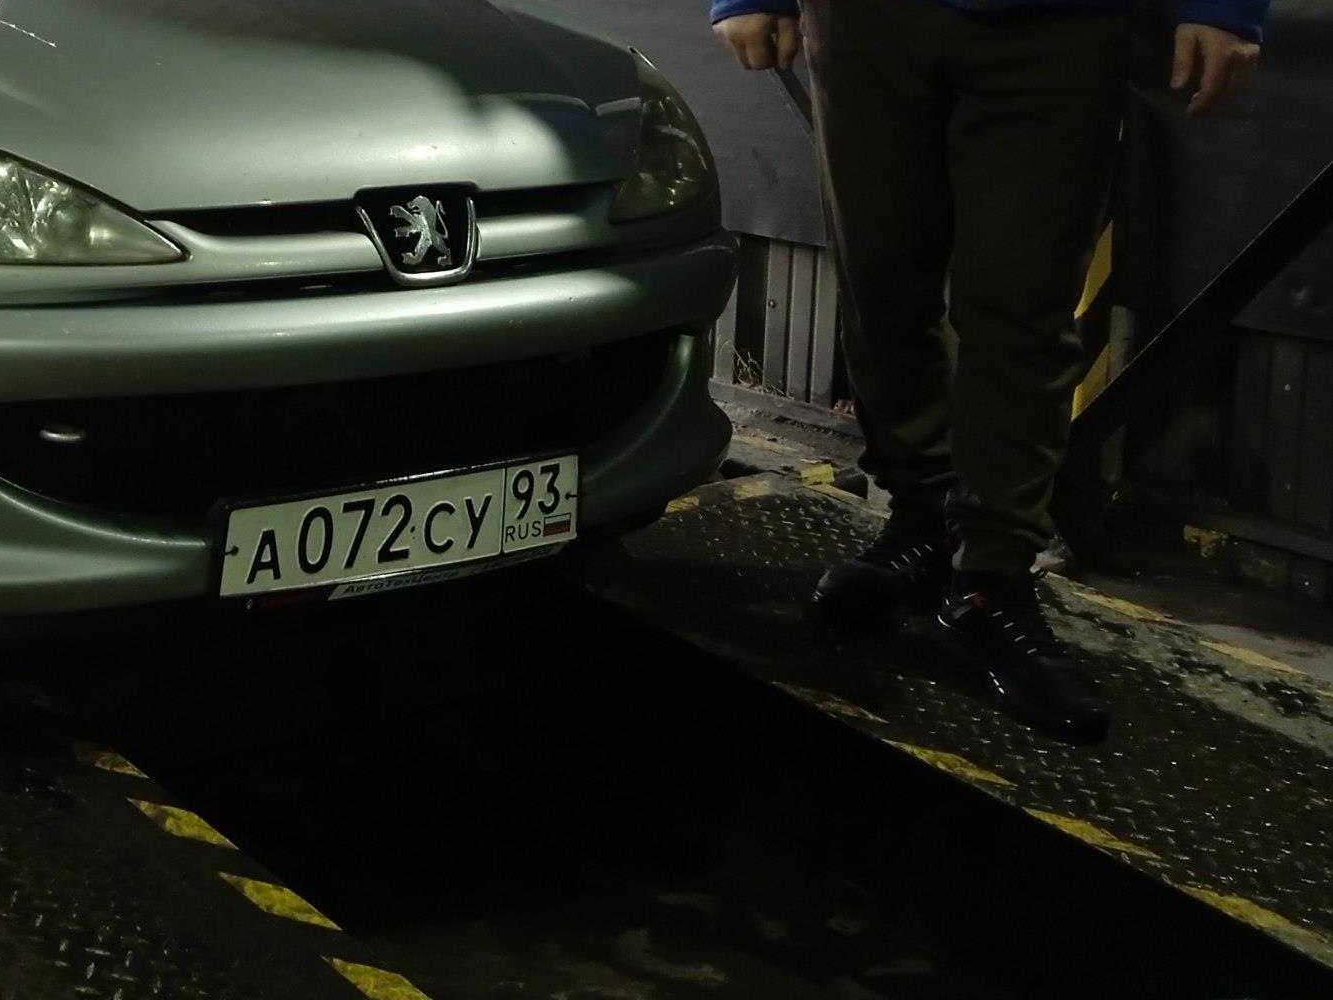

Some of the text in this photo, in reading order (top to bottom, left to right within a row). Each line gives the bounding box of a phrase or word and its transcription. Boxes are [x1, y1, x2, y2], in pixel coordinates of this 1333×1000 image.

[511, 463, 562, 521] 93
[245, 493, 493, 585] А072СУ
[505, 519, 542, 544] RUS
